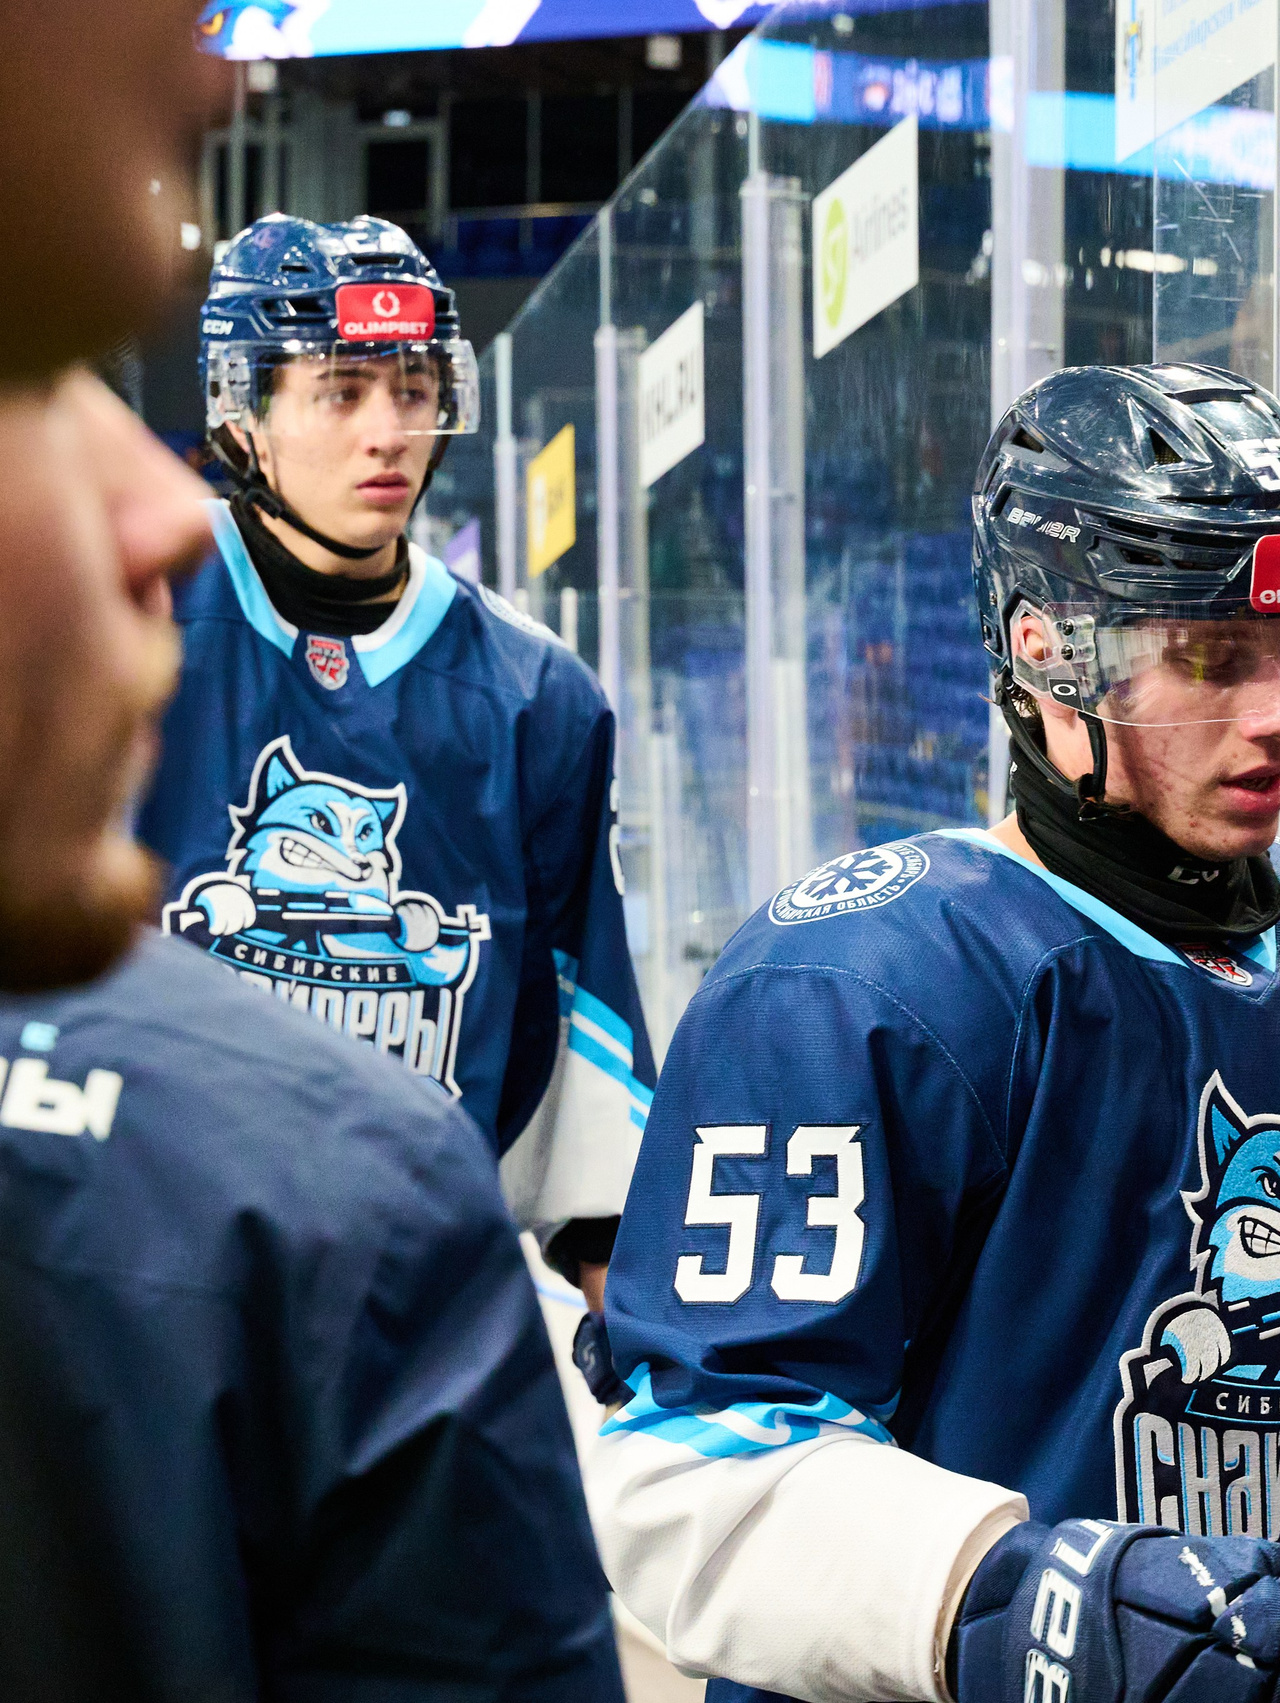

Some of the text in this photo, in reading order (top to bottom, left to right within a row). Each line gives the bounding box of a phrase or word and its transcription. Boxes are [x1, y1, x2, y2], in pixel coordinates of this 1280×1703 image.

[343, 321, 429, 335] OLIMPBET
[837, 883, 901, 910] ОБЛАСТЬ
[233, 943, 398, 983] СИБИРСКИЕ
[673, 1123, 867, 1304] 53
